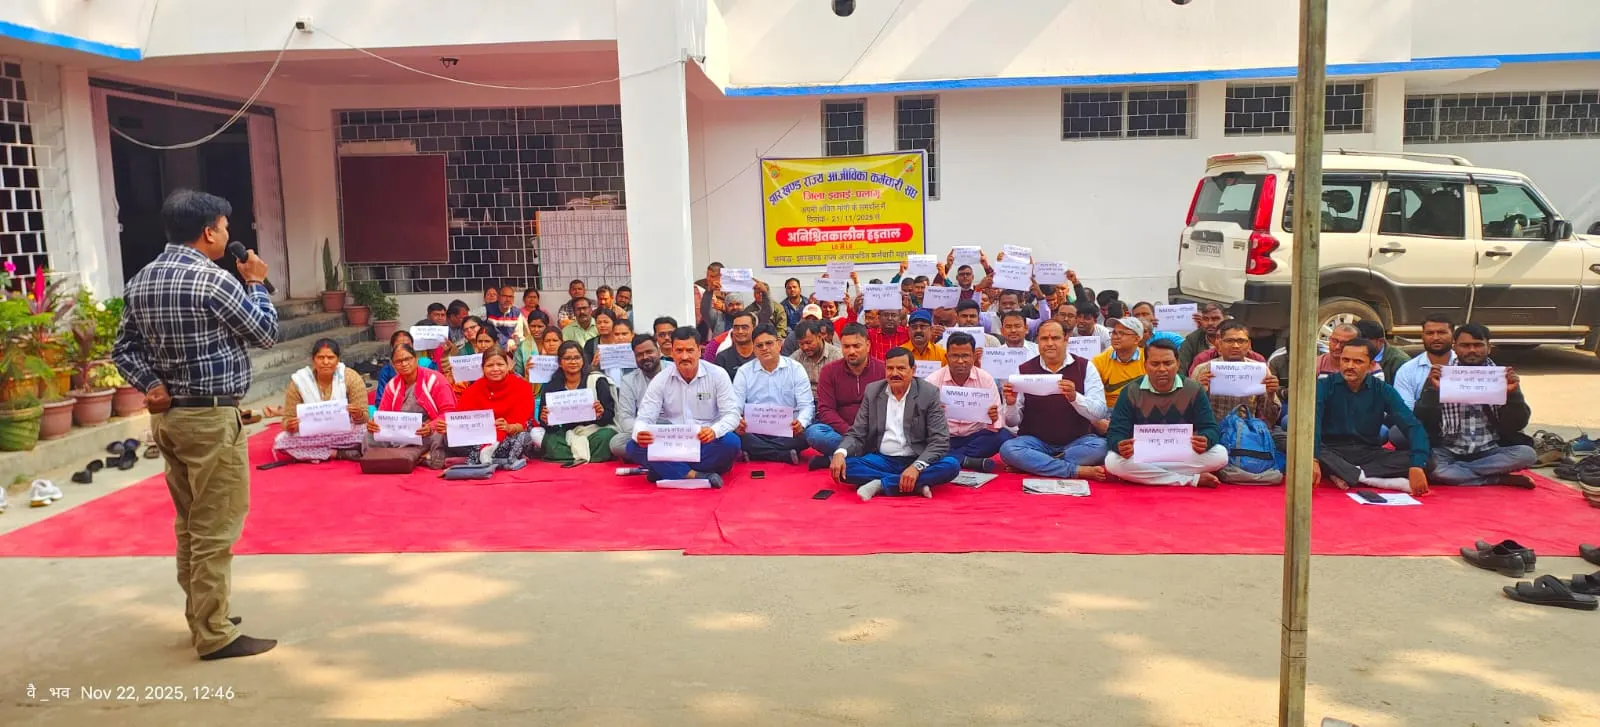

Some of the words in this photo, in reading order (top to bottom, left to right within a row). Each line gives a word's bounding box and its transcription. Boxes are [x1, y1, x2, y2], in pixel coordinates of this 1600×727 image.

[803, 173, 824, 187] राज्य
[827, 168, 868, 182] आजीविका
[871, 173, 904, 192] कर्मचारी
[803, 191, 825, 201] जिला
[787, 226, 866, 243] अनिश्चितकालीन
[866, 228, 902, 243] हड़ताल
